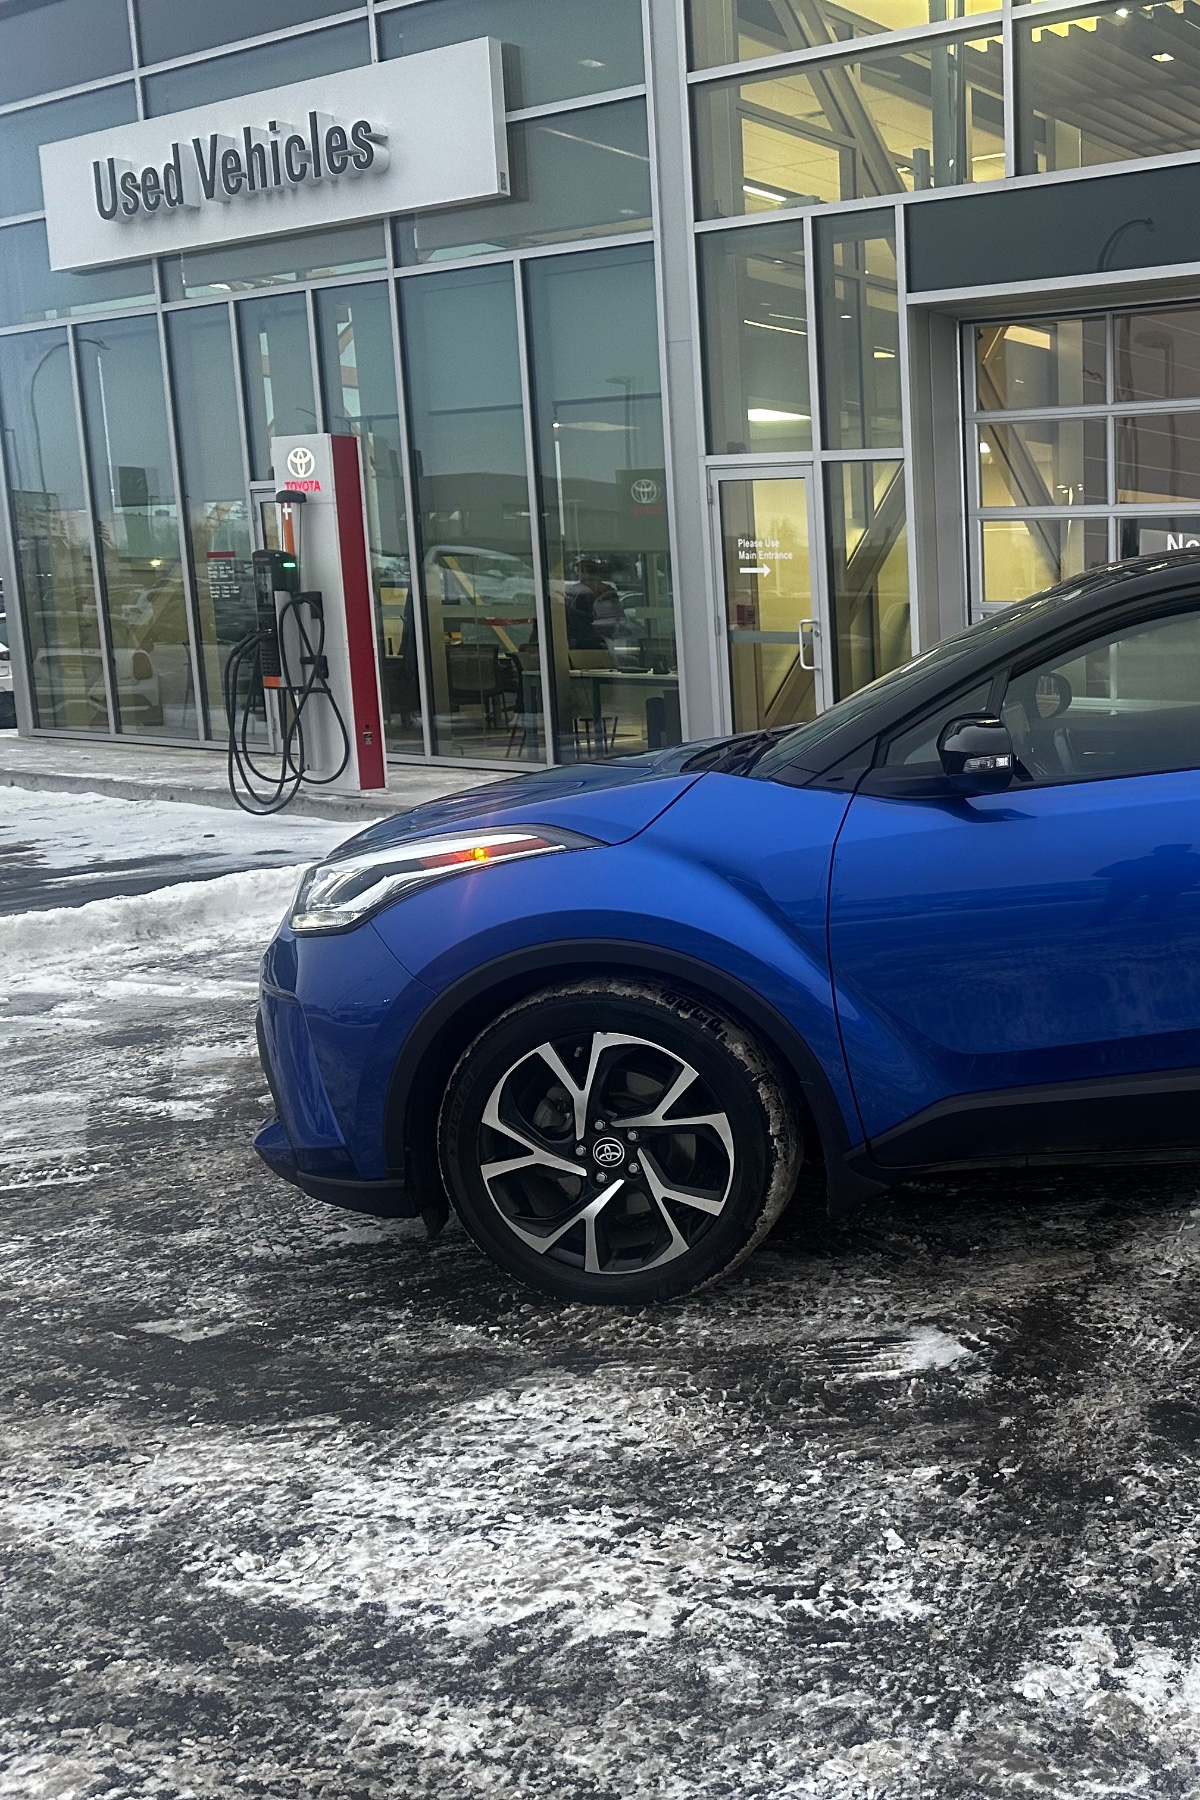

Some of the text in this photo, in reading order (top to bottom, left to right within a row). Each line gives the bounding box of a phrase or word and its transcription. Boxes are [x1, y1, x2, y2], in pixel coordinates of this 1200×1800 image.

[92, 111, 375, 221] Used Vehicles
[284, 481, 322, 492] TOYOTA
[738, 538, 780, 548] Please Use
[738, 550, 793, 560] Main Entrance
